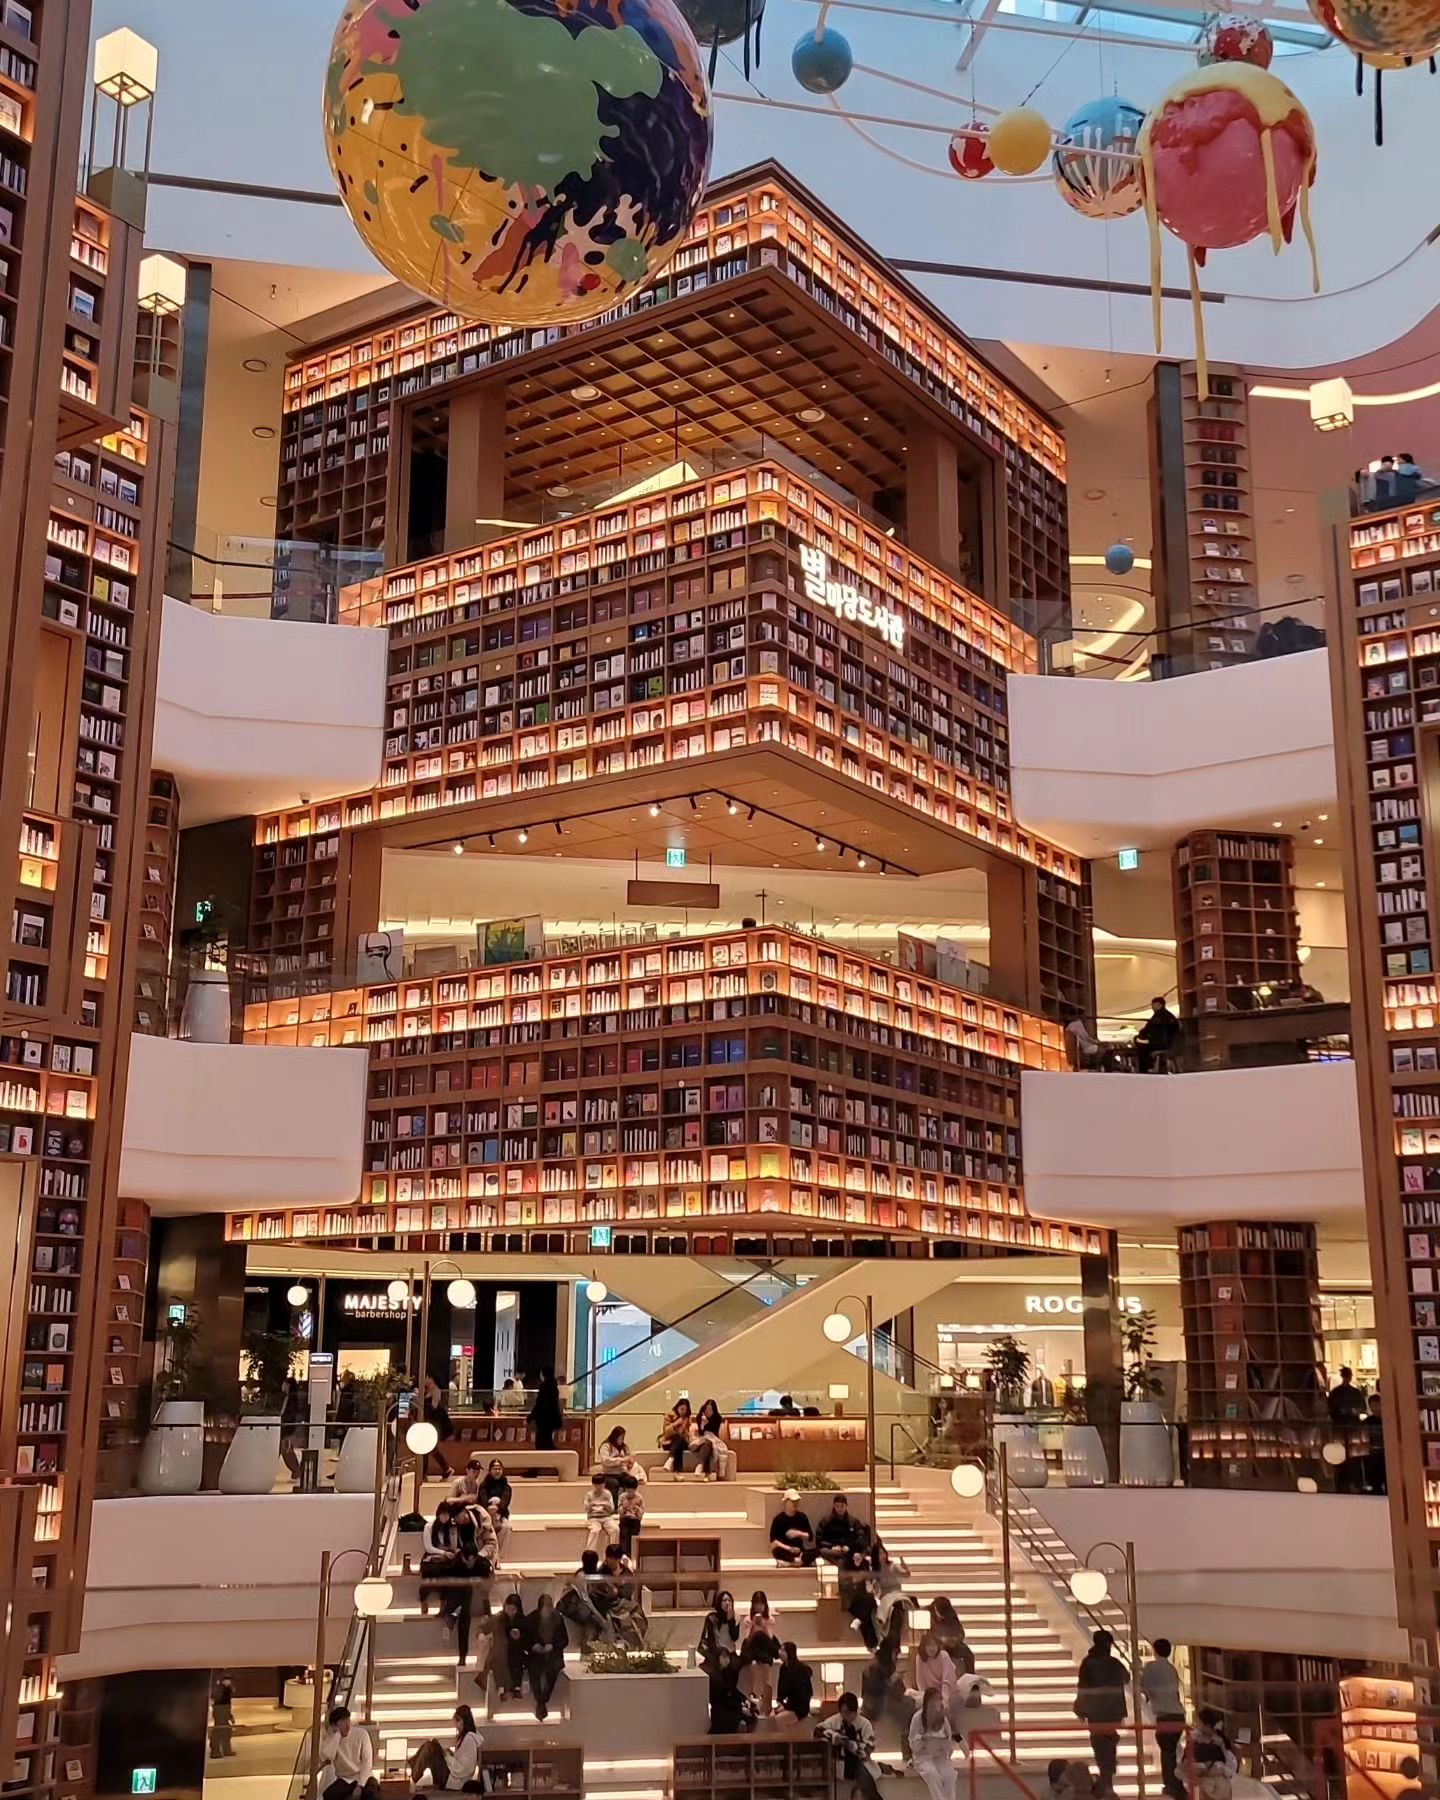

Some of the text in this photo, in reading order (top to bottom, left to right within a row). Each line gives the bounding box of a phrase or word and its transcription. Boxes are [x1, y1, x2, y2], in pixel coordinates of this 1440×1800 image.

[799, 543, 904, 649] 별마당도서관
[344, 1295, 422, 1310] MAJESTY
[1025, 1295, 1142, 1313] ROGIS
[355, 1310, 406, 1320] barbershop
